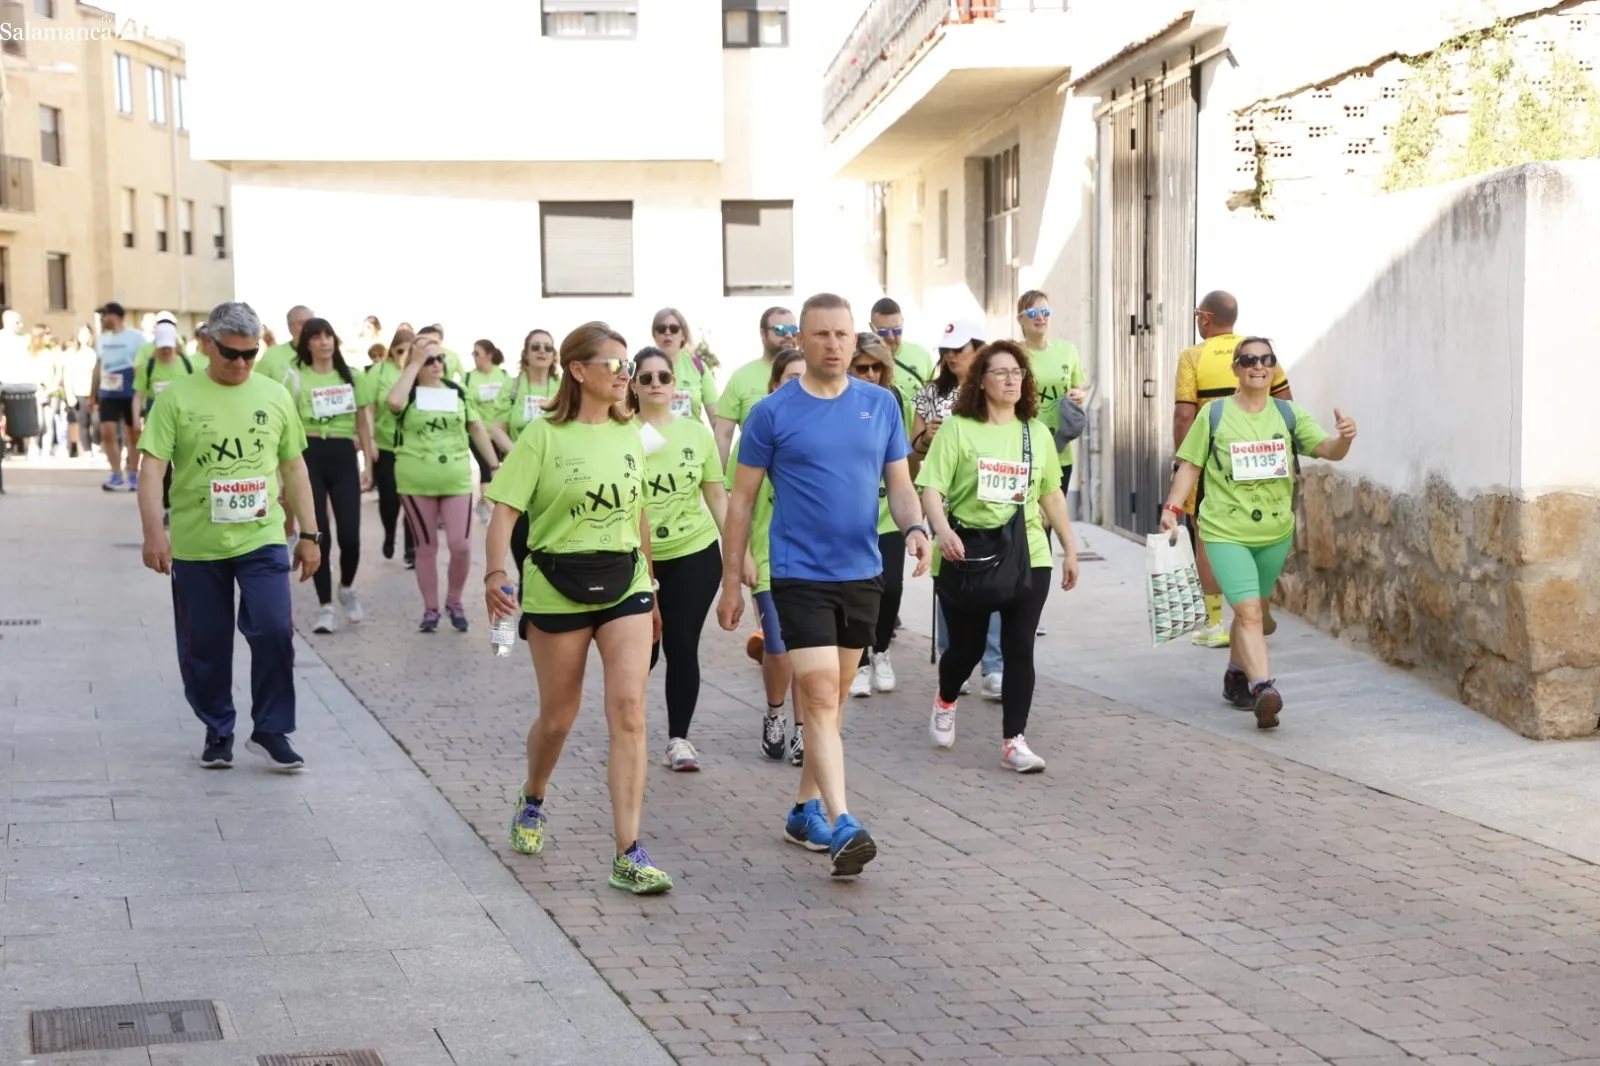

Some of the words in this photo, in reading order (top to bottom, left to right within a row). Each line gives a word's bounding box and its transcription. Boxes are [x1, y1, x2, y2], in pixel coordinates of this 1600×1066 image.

[425, 417, 448, 432] XI
[211, 437, 243, 462] XI
[1232, 442, 1285, 454] bedunia
[979, 459, 1028, 475] bedunia
[1242, 454, 1277, 468] 1135
[212, 481, 266, 493] bedunia
[648, 473, 677, 497] XI
[986, 473, 1018, 491] 1013
[229, 494, 256, 509] 638
[585, 483, 621, 511] XI
